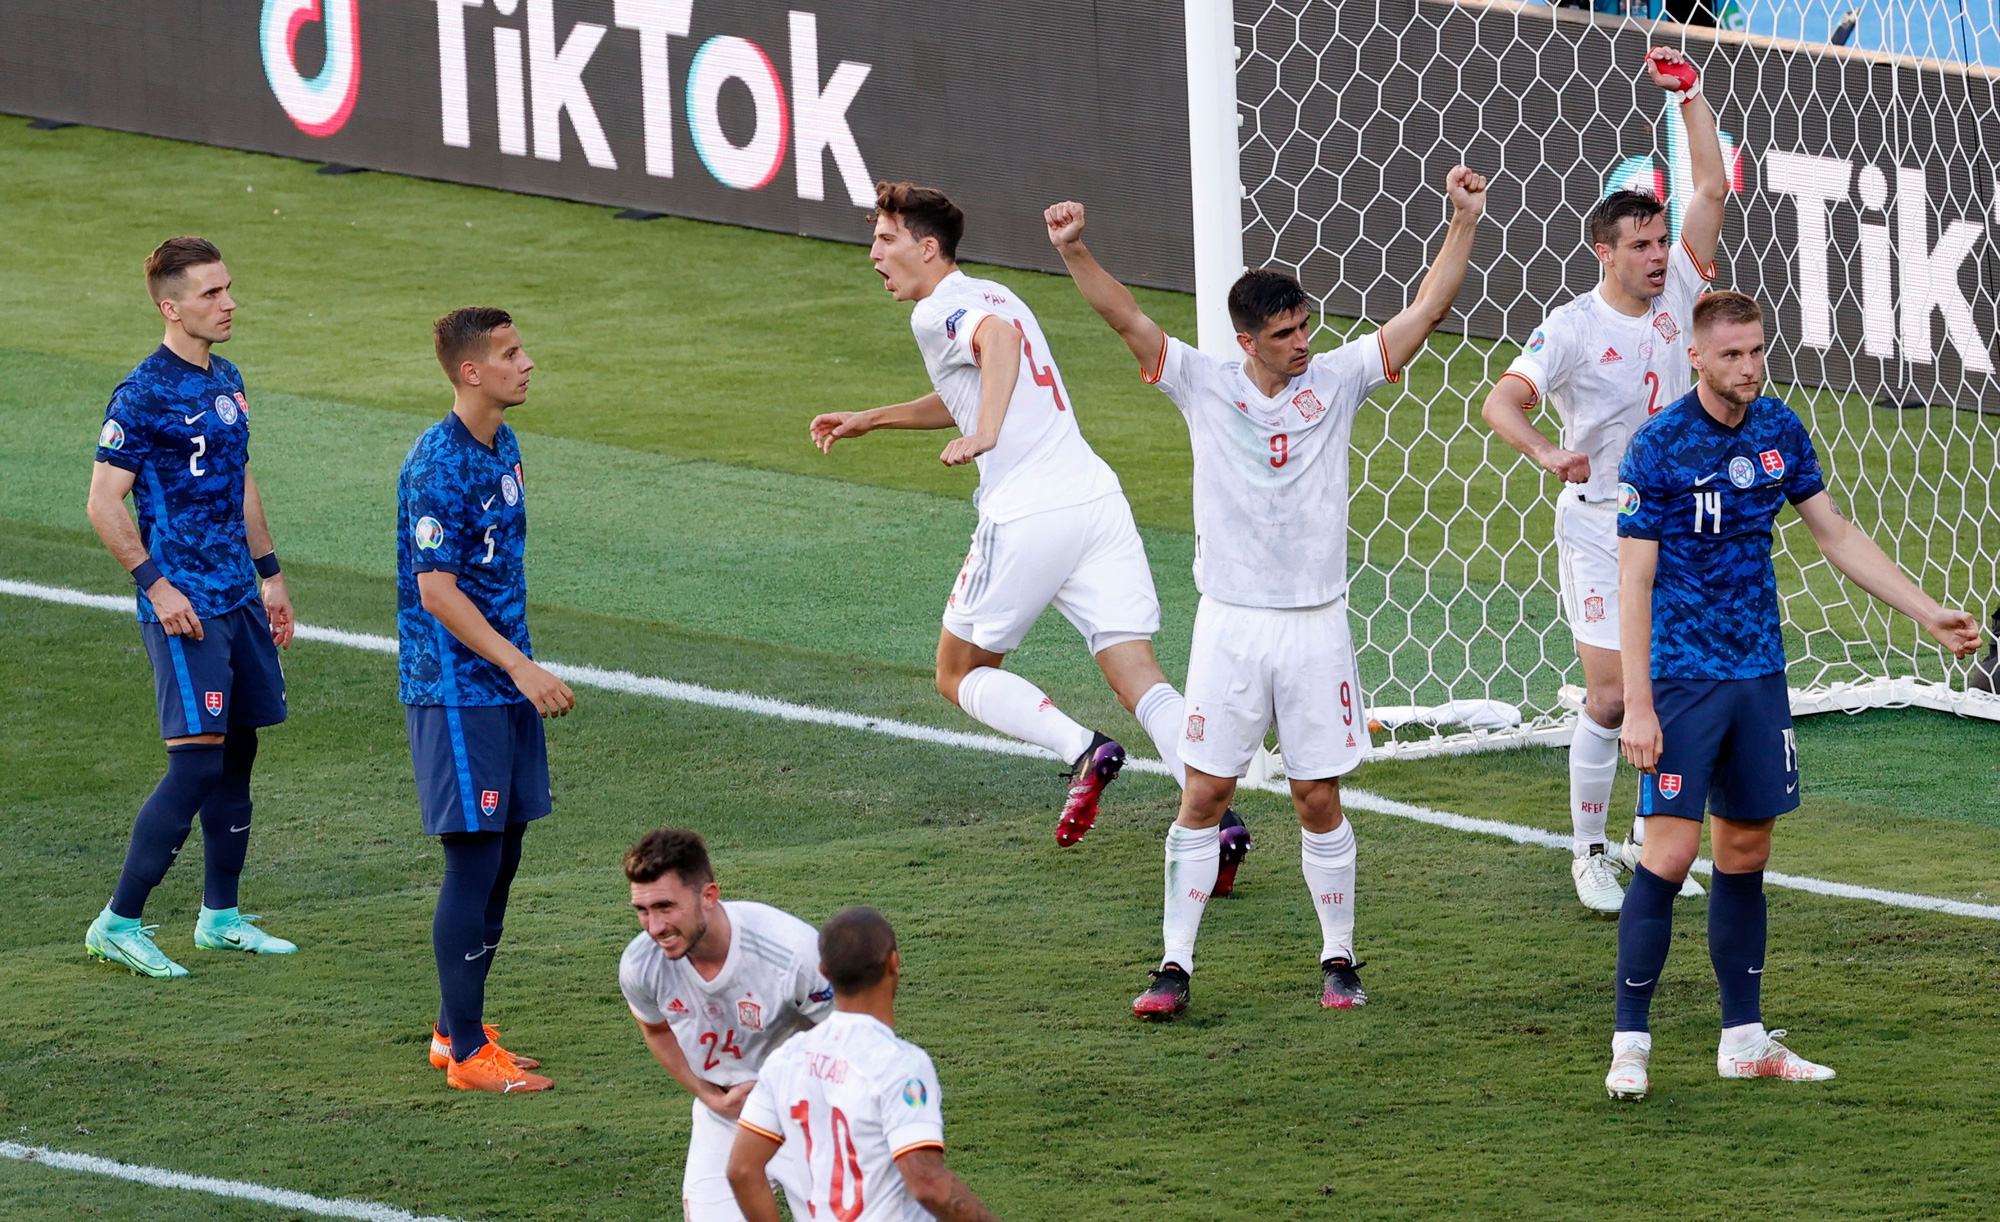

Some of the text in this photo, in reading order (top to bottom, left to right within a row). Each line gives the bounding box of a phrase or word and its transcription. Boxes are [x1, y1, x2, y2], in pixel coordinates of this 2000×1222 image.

[437, 0, 878, 208] TikTok
[1766, 149, 2000, 375] Tik
[1013, 318, 1066, 411] 4
[1644, 371, 1664, 416] 2
[189, 434, 206, 477] 2
[1270, 433, 1288, 468] 9
[1693, 491, 1721, 534] 14
[481, 524, 498, 564] 5
[1340, 681, 1352, 726] 9
[1781, 727, 1798, 772] 14
[1581, 801, 1605, 814] RFEF
[1188, 888, 1210, 904] RFEF
[1321, 893, 1345, 905] RFEF
[700, 1029, 742, 1071] 24
[791, 1100, 864, 1222] 10
